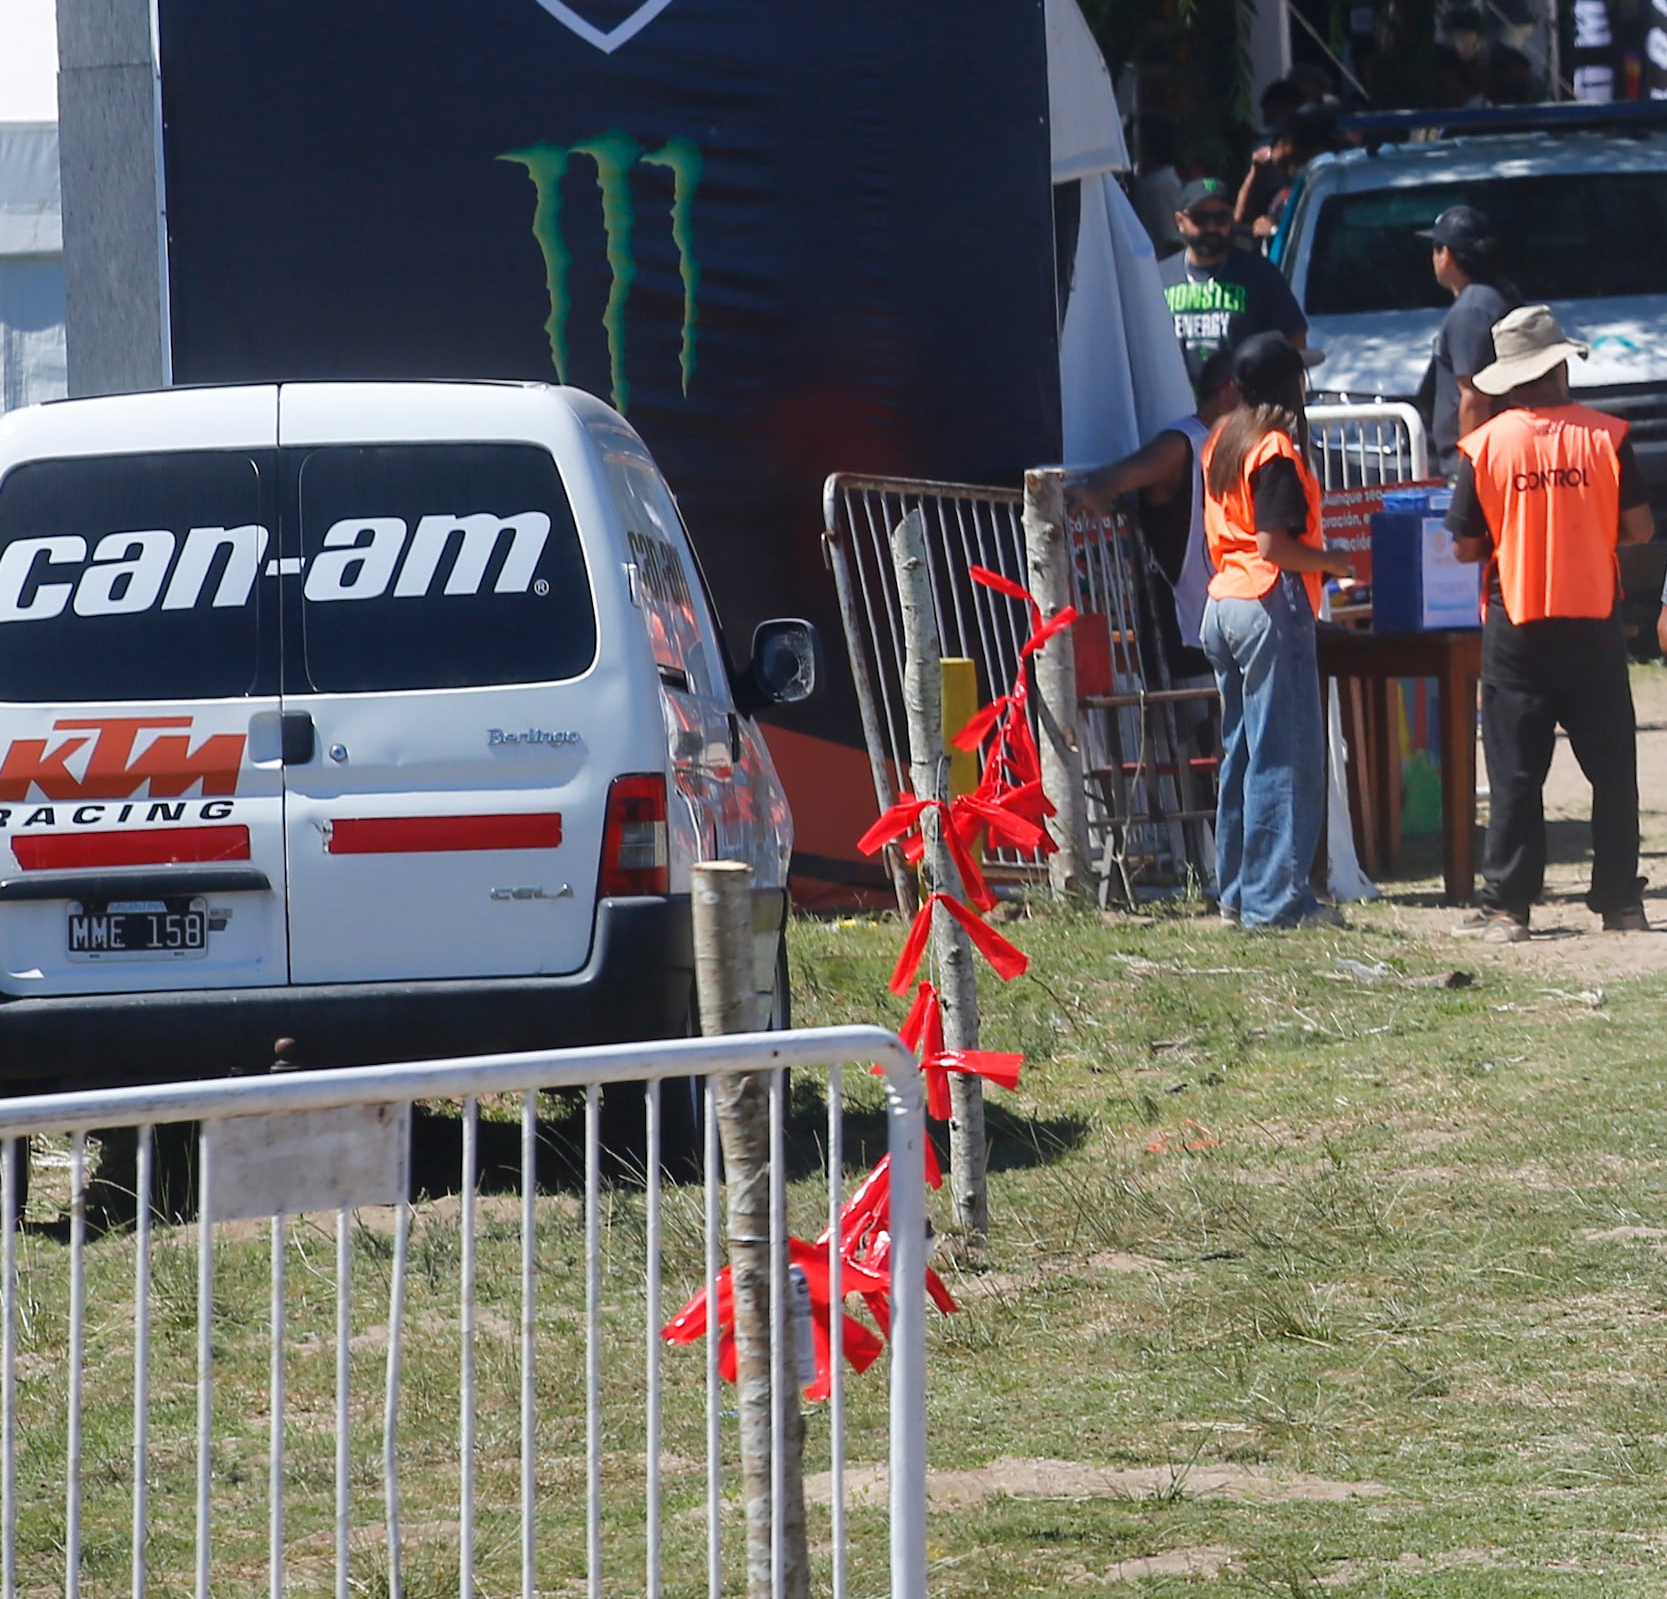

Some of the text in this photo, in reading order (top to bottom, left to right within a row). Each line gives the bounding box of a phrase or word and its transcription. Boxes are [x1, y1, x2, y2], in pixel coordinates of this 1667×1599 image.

[1513, 467, 1589, 492] CONTROL
[0, 510, 552, 623] can-am
[487, 727, 581, 748] Berlingo
[0, 716, 247, 803] KTM
[71, 914, 201, 949] MME 158
